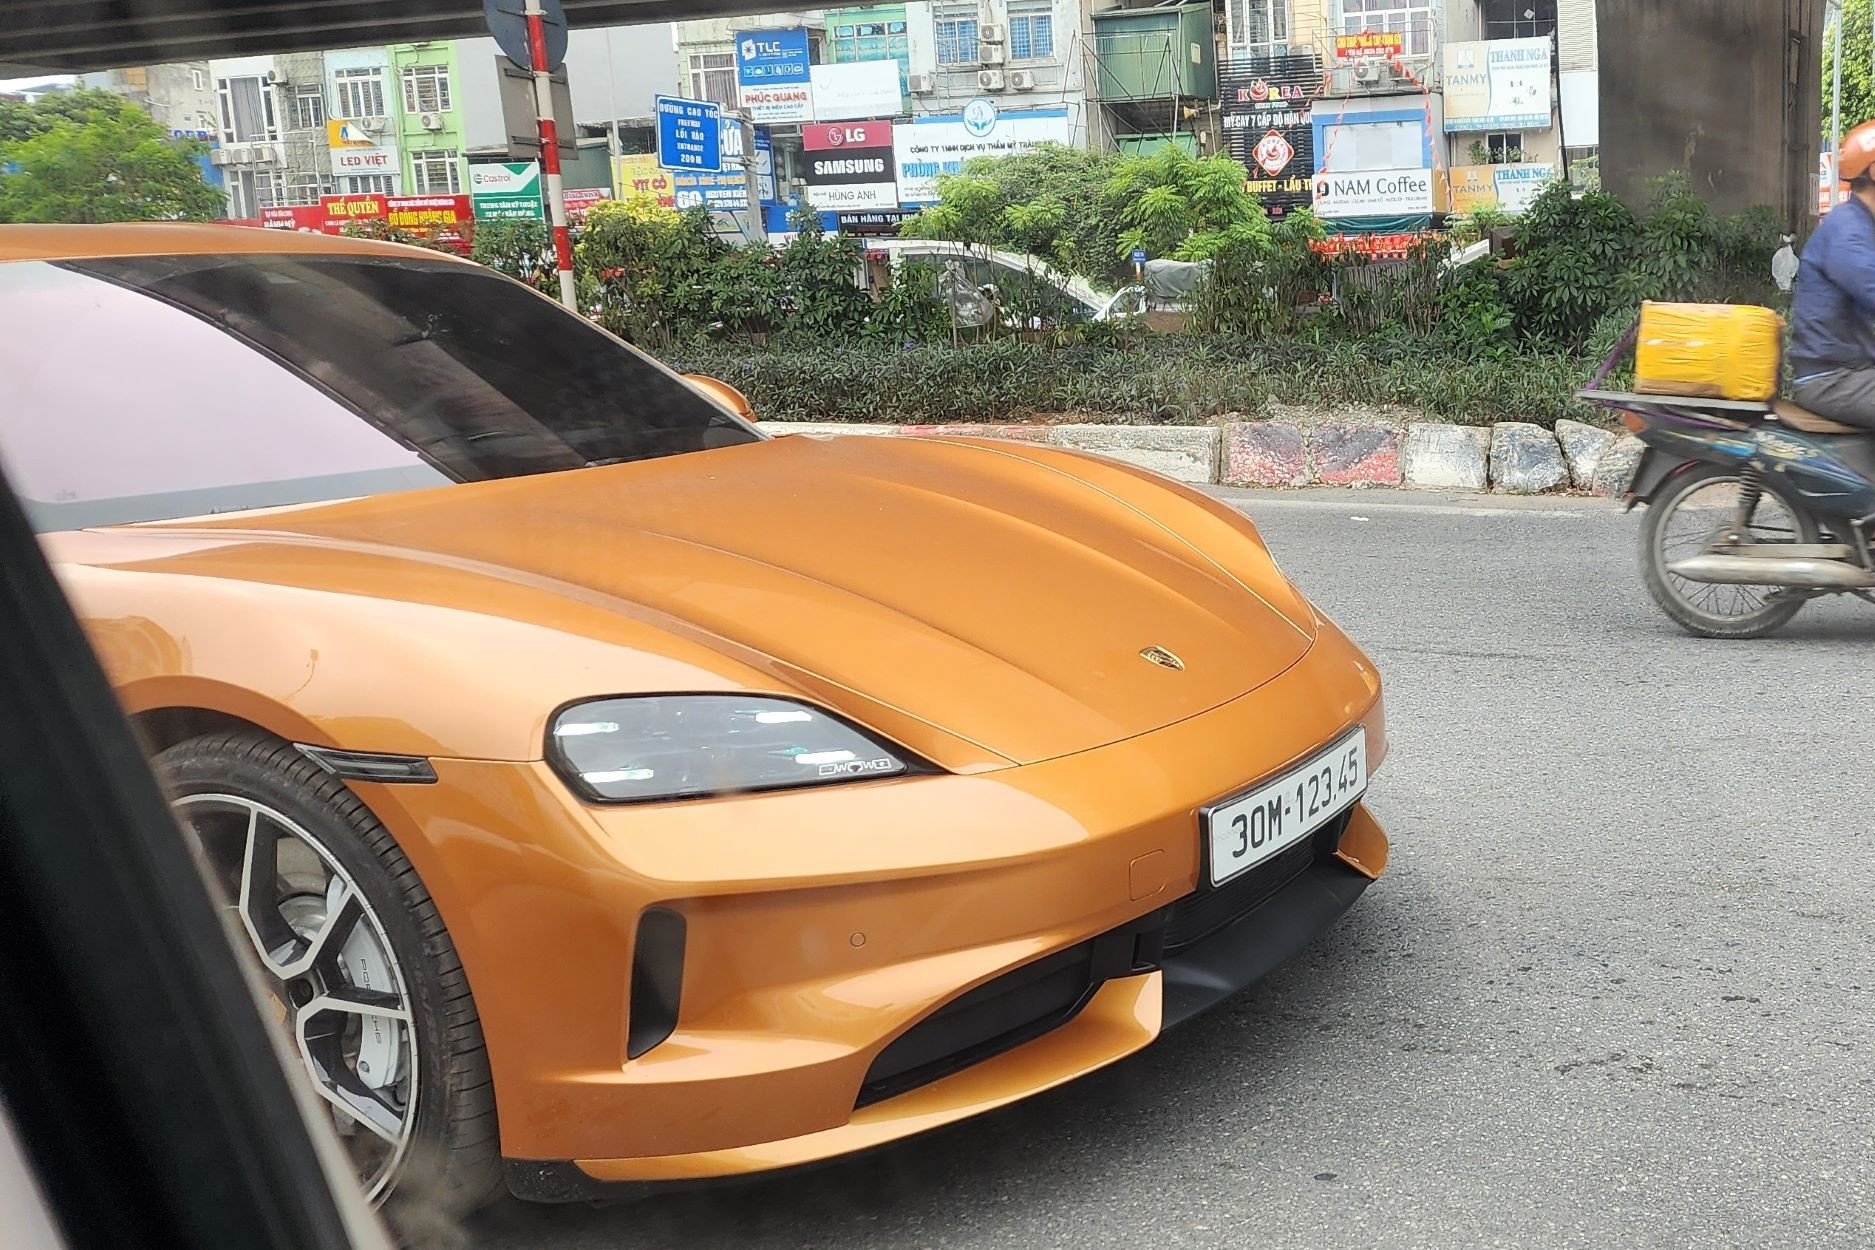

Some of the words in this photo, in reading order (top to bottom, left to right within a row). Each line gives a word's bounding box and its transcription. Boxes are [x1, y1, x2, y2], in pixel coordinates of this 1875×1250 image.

[756, 42, 780, 52] TLC
[1490, 48, 1524, 62] THANH
[1526, 48, 1548, 61] NGA
[1446, 74, 1486, 86] TANMY
[772, 92, 808, 102] QUANG
[660, 102, 684, 114] ĐƯỜNG
[686, 106, 702, 116] CAO
[704, 108, 718, 118] TỐC
[1236, 115, 1250, 128] CAY
[1251, 115, 1256, 127] 7
[1257, 111, 1272, 126] CẤP
[1273, 111, 1284, 128] ĐỘ
[675, 128, 688, 139] LỐI
[846, 128, 865, 143] LG
[340, 156, 361, 166] LED
[364, 153, 388, 167] VIỆT
[814, 158, 884, 175] SAMSUNG
[484, 174, 510, 182] Castrol
[1496, 169, 1530, 180] THANH
[1247, 180, 1278, 192] BUFFET
[1335, 179, 1370, 196] NAM
[1376, 176, 1427, 194] Coffee
[1453, 184, 1493, 194] TANMY
[828, 189, 855, 201] HÙNG
[857, 190, 876, 200] ANH
[327, 196, 346, 215] THẾ
[399, 207, 418, 225] ĐỒNG
[443, 210, 457, 224] GIA
[841, 213, 858, 224] BÁN
[860, 213, 884, 223] HÀNG
[1232, 746, 1358, 858] 30M-123.45
